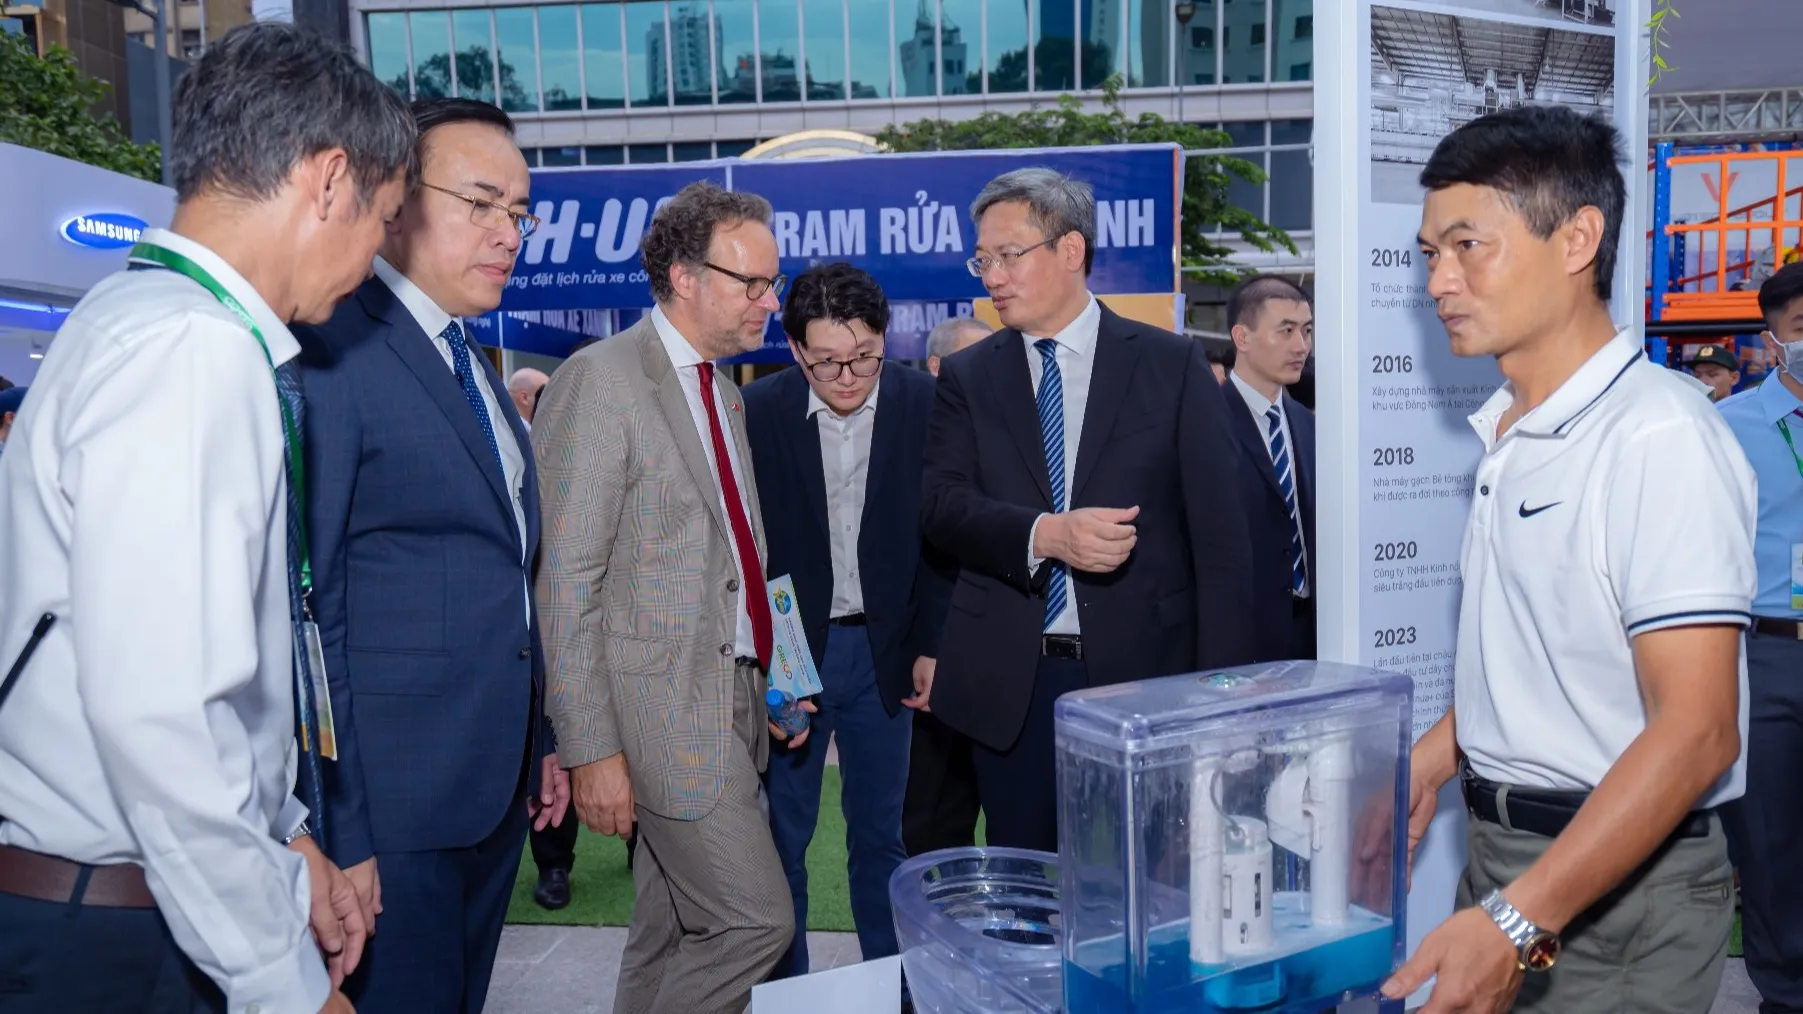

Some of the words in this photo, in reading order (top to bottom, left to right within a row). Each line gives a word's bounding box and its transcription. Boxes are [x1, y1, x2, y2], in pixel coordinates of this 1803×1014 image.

[516, 196, 671, 265] H-U
[879, 190, 963, 255] RỬA
[1094, 198, 1155, 248] NH
[1371, 248, 1412, 268] 2014
[556, 271, 580, 288] lịch
[582, 269, 607, 285] rửa
[608, 272, 626, 284] xe
[1372, 355, 1413, 374] 2016
[1372, 400, 1388, 411] khu
[1428, 400, 1446, 410] Nam
[1373, 446, 1414, 466] 2018
[1373, 477, 1390, 488] Nhà
[1391, 476, 1409, 488] máy
[1409, 491, 1417, 500] ra
[1432, 488, 1450, 498] theo
[1374, 541, 1418, 561] 2020
[1396, 567, 1405, 578] ty
[1406, 565, 1429, 576] TNHH
[1373, 582, 1391, 593] siêu
[1374, 626, 1417, 649] 2023
